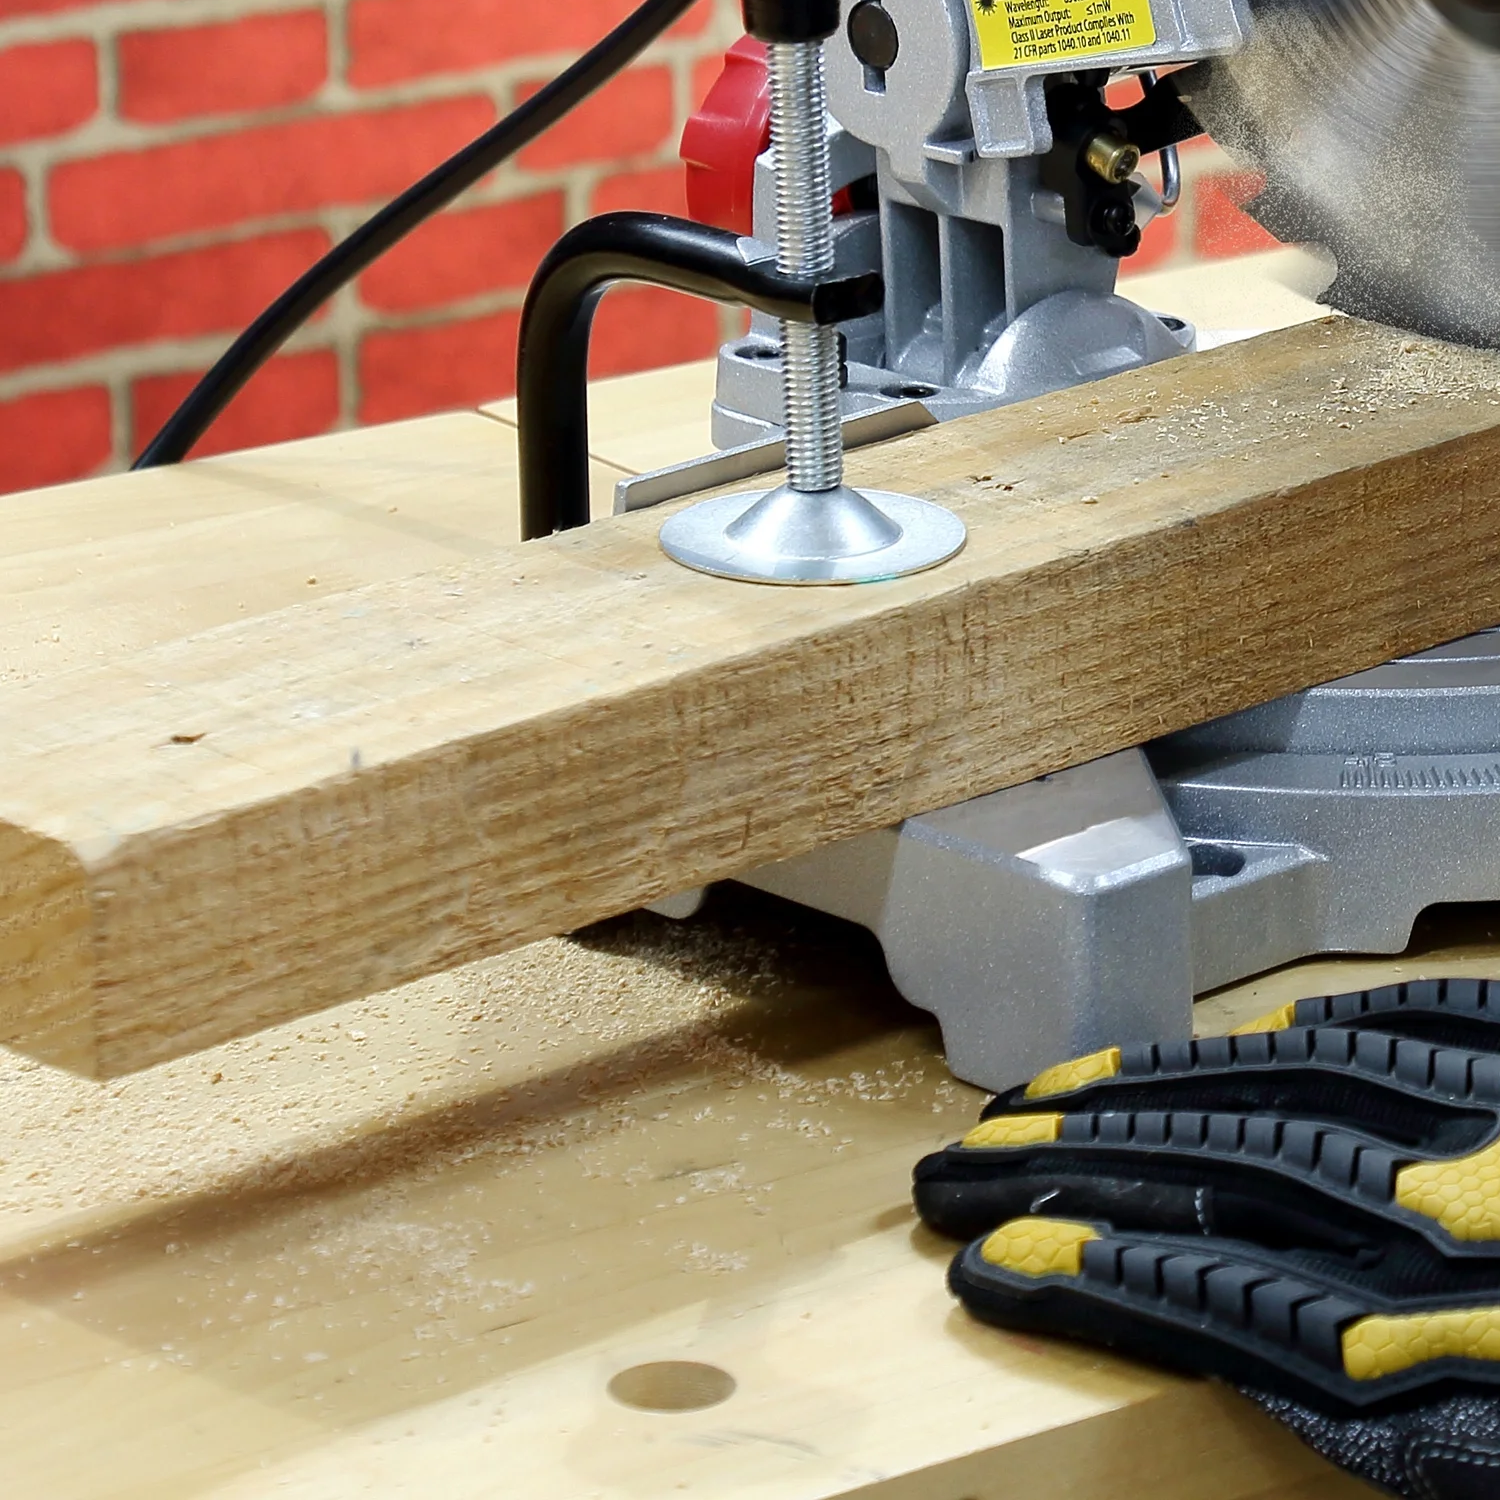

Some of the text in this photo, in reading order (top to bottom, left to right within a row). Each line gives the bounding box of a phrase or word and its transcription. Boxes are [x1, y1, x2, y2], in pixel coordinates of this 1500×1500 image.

[1008, 13, 1044, 29] Maximum
[1043, 8, 1072, 24] Output:
[1011, 30, 1030, 44] Class
[1036, 26, 1055, 40] Laser
[1054, 21, 1083, 36] Product
[1083, 15, 1116, 32] Complies
[1116, 11, 1135, 26] With
[1013, 28, 1131, 60] 21 CFR parts 1040.10 and 1040.11
